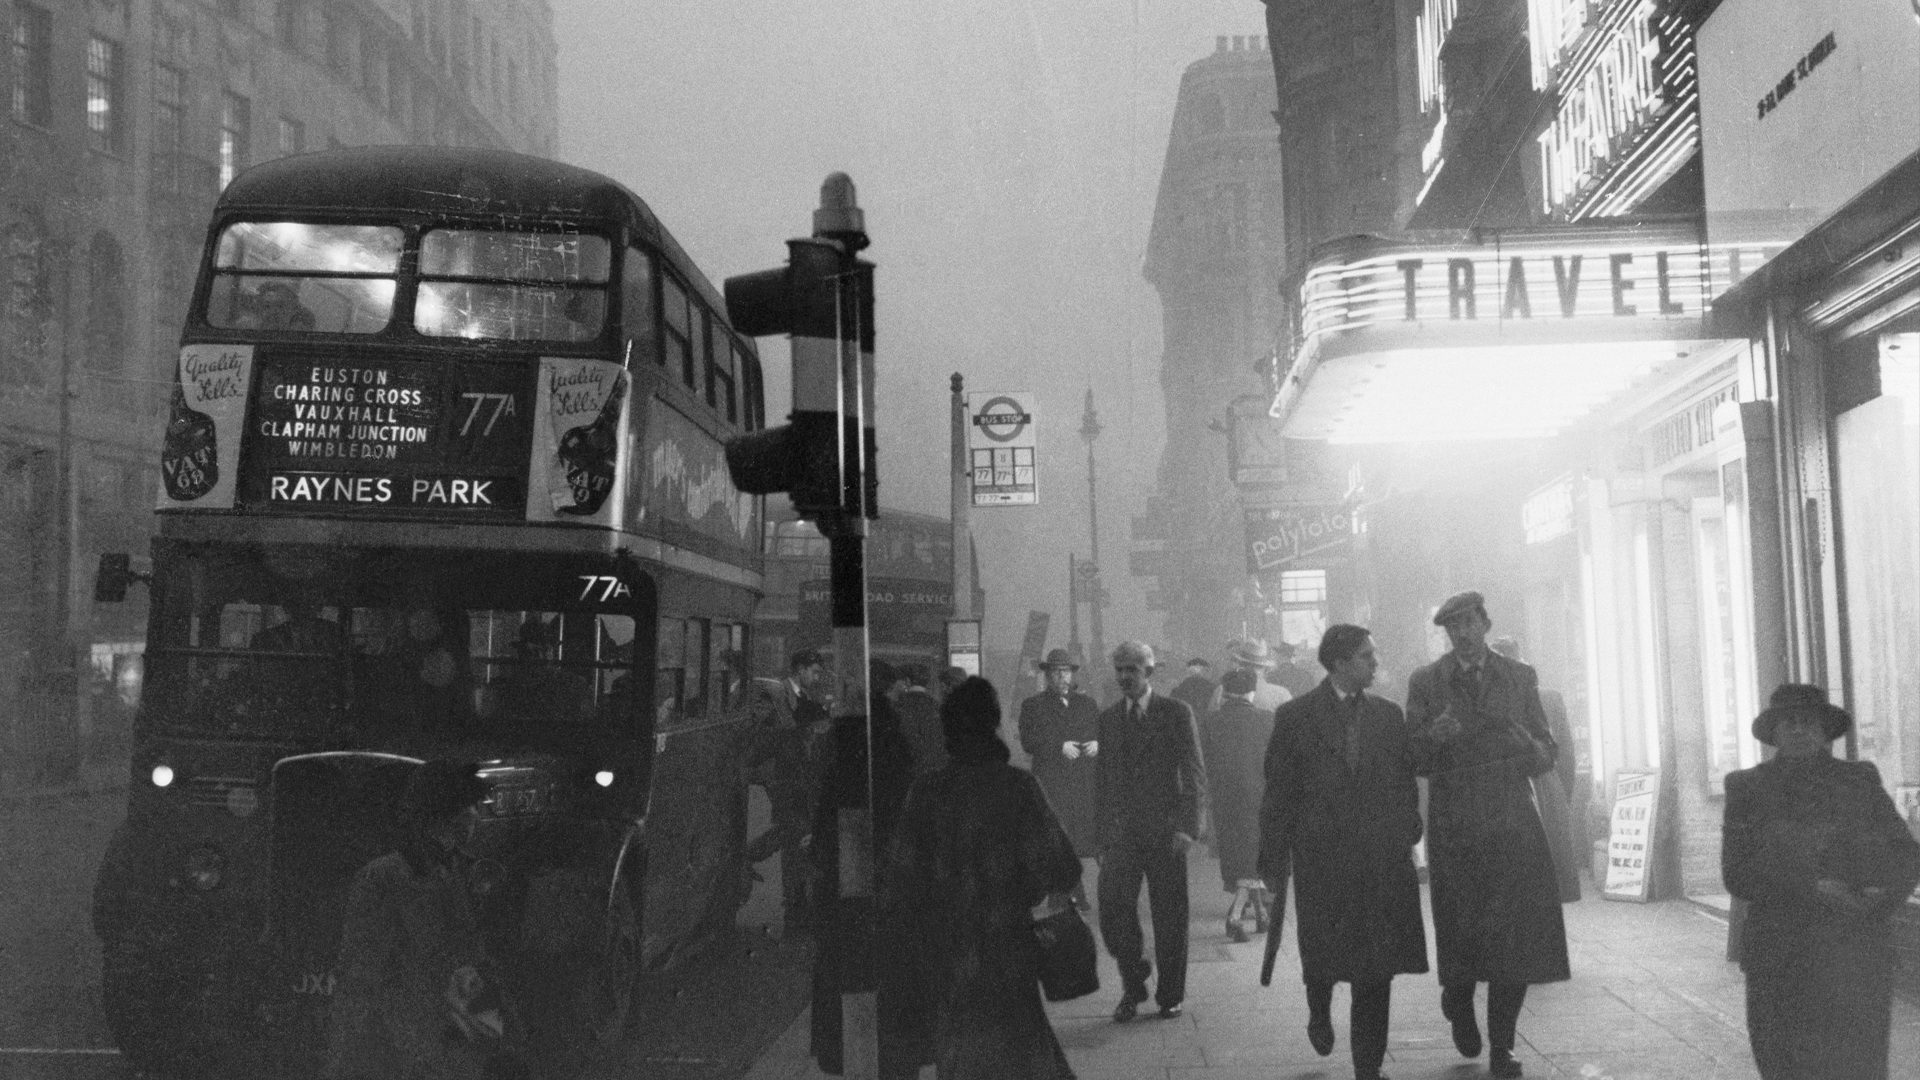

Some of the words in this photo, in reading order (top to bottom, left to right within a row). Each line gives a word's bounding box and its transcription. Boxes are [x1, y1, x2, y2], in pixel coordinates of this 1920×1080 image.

[1396, 252, 1684, 321] TRAVEL
[185, 353, 246, 382] Quality
[311, 367, 387, 385] EUSTON
[274, 384, 355, 402] CHARING
[364, 388, 422, 405] CROSS
[295, 404, 397, 422] VAUXHALL
[460, 392, 516, 436] 77A
[980, 416, 998, 424] BUS
[1001, 415, 1023, 423] STOP
[261, 421, 341, 438] CLAPHAM
[348, 426, 427, 442] JUNCTION
[289, 441, 397, 459] WIMBLEDON
[271, 476, 392, 502] RAYNES
[412, 479, 492, 504] PARK
[578, 575, 632, 601] 77A
[866, 593, 894, 603] OAD
